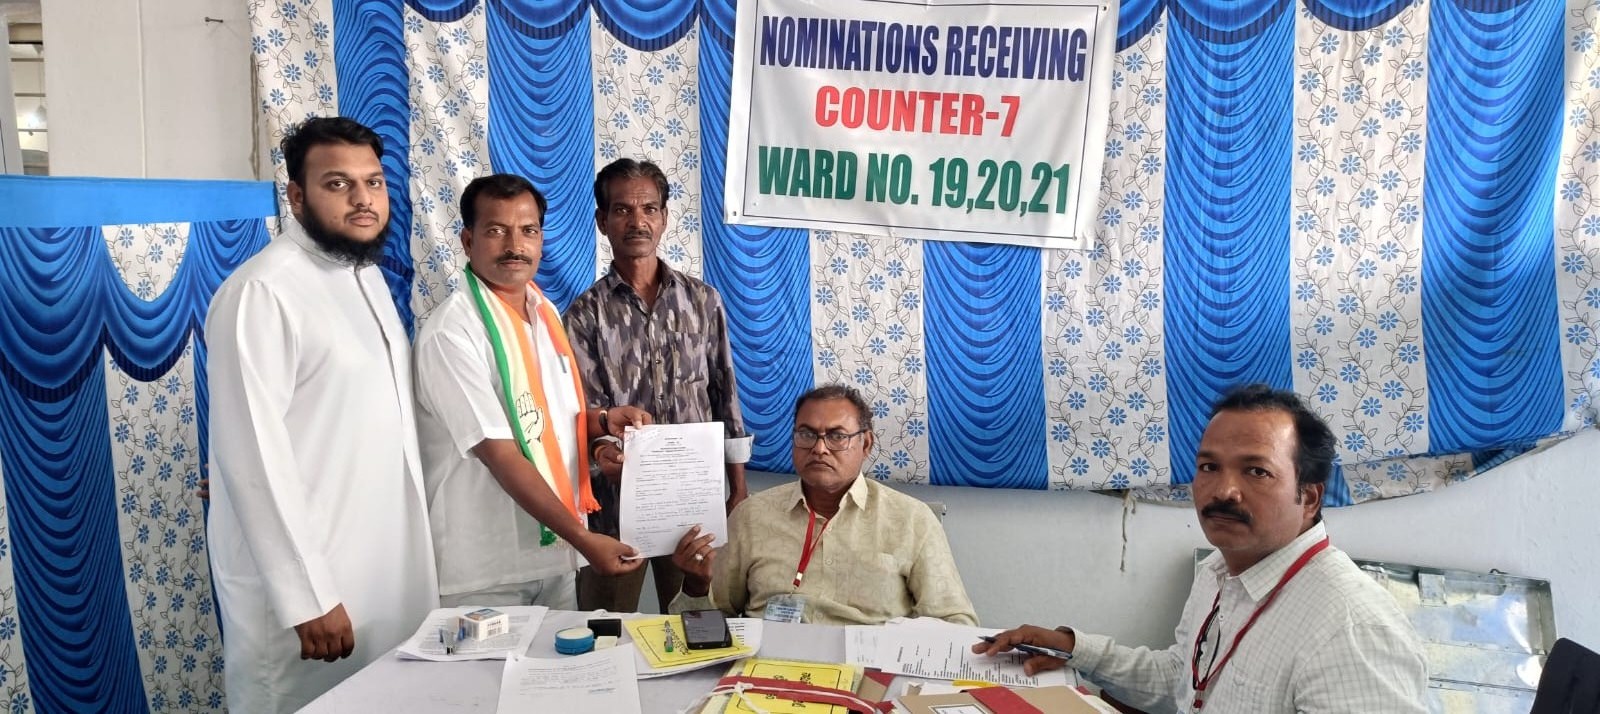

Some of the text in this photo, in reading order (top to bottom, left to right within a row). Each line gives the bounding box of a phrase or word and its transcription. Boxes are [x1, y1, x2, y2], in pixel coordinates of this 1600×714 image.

[760, 16, 1087, 82] NOMINATIONS RECEIVING
[815, 86, 1020, 137] COUNTER-7
[758, 146, 1070, 216] WARD NO. 19,20,21
